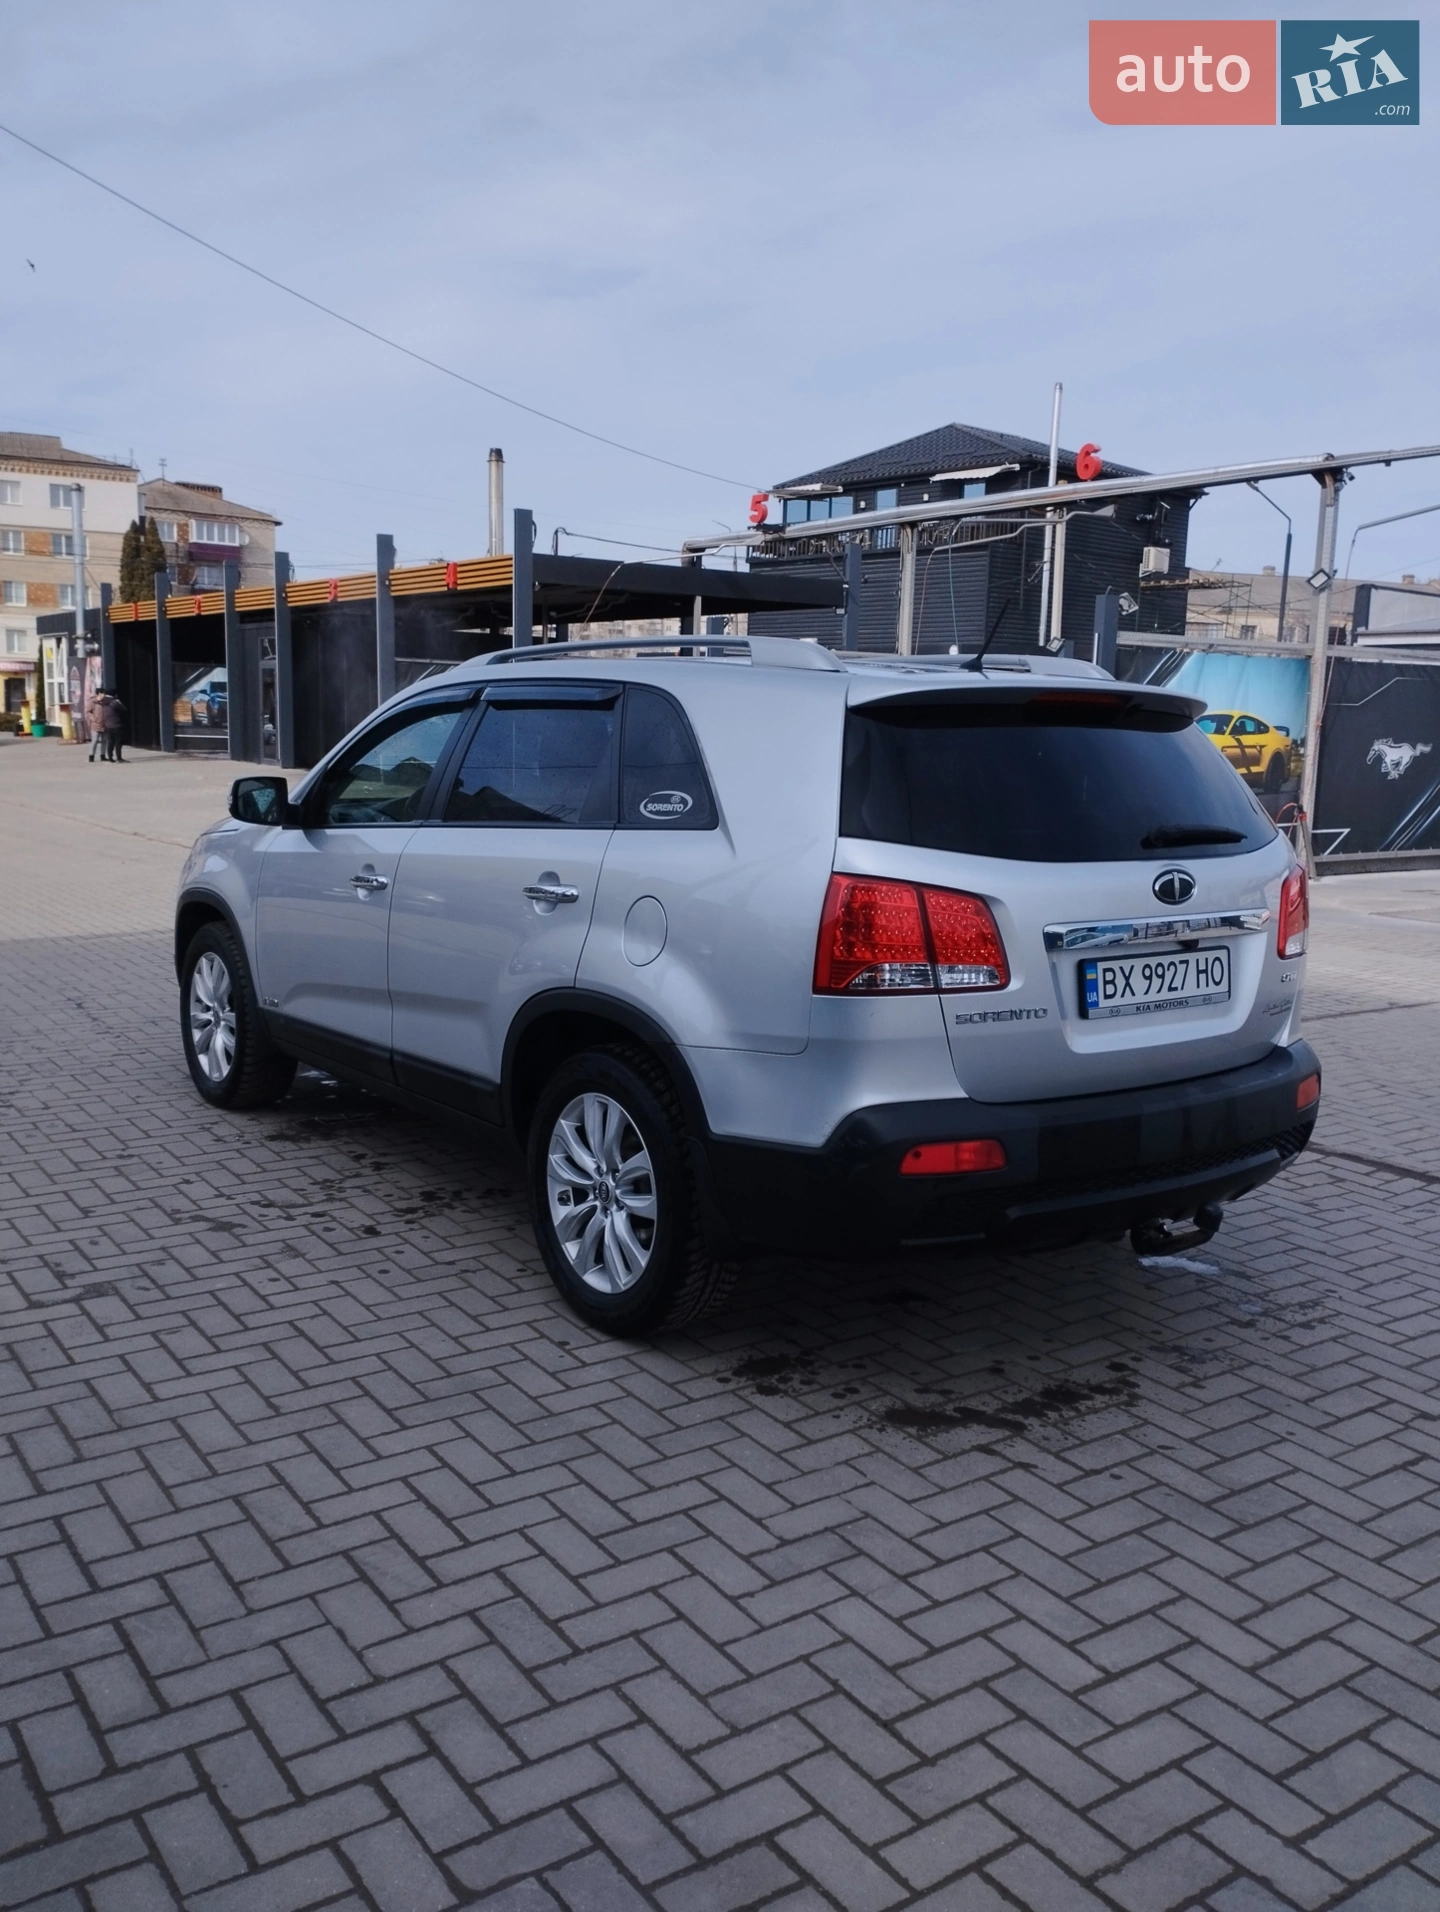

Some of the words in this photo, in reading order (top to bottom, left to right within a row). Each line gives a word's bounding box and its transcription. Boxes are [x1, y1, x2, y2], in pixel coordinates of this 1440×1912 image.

[1076, 443, 1102, 480] 6
[749, 493, 769, 524] 5
[445, 562, 458, 589] 4
[328, 578, 338, 602] 3
[646, 803, 684, 811] SORENTO
[1102, 965, 1136, 1000] BX
[1141, 959, 1190, 995] 9927
[1196, 956, 1225, 989] HO
[1086, 992, 1098, 1002] UA
[1135, 1002, 1151, 1013] KIA
[1154, 999, 1190, 1011] MOTORS
[955, 1007, 1048, 1025] SORENTO
